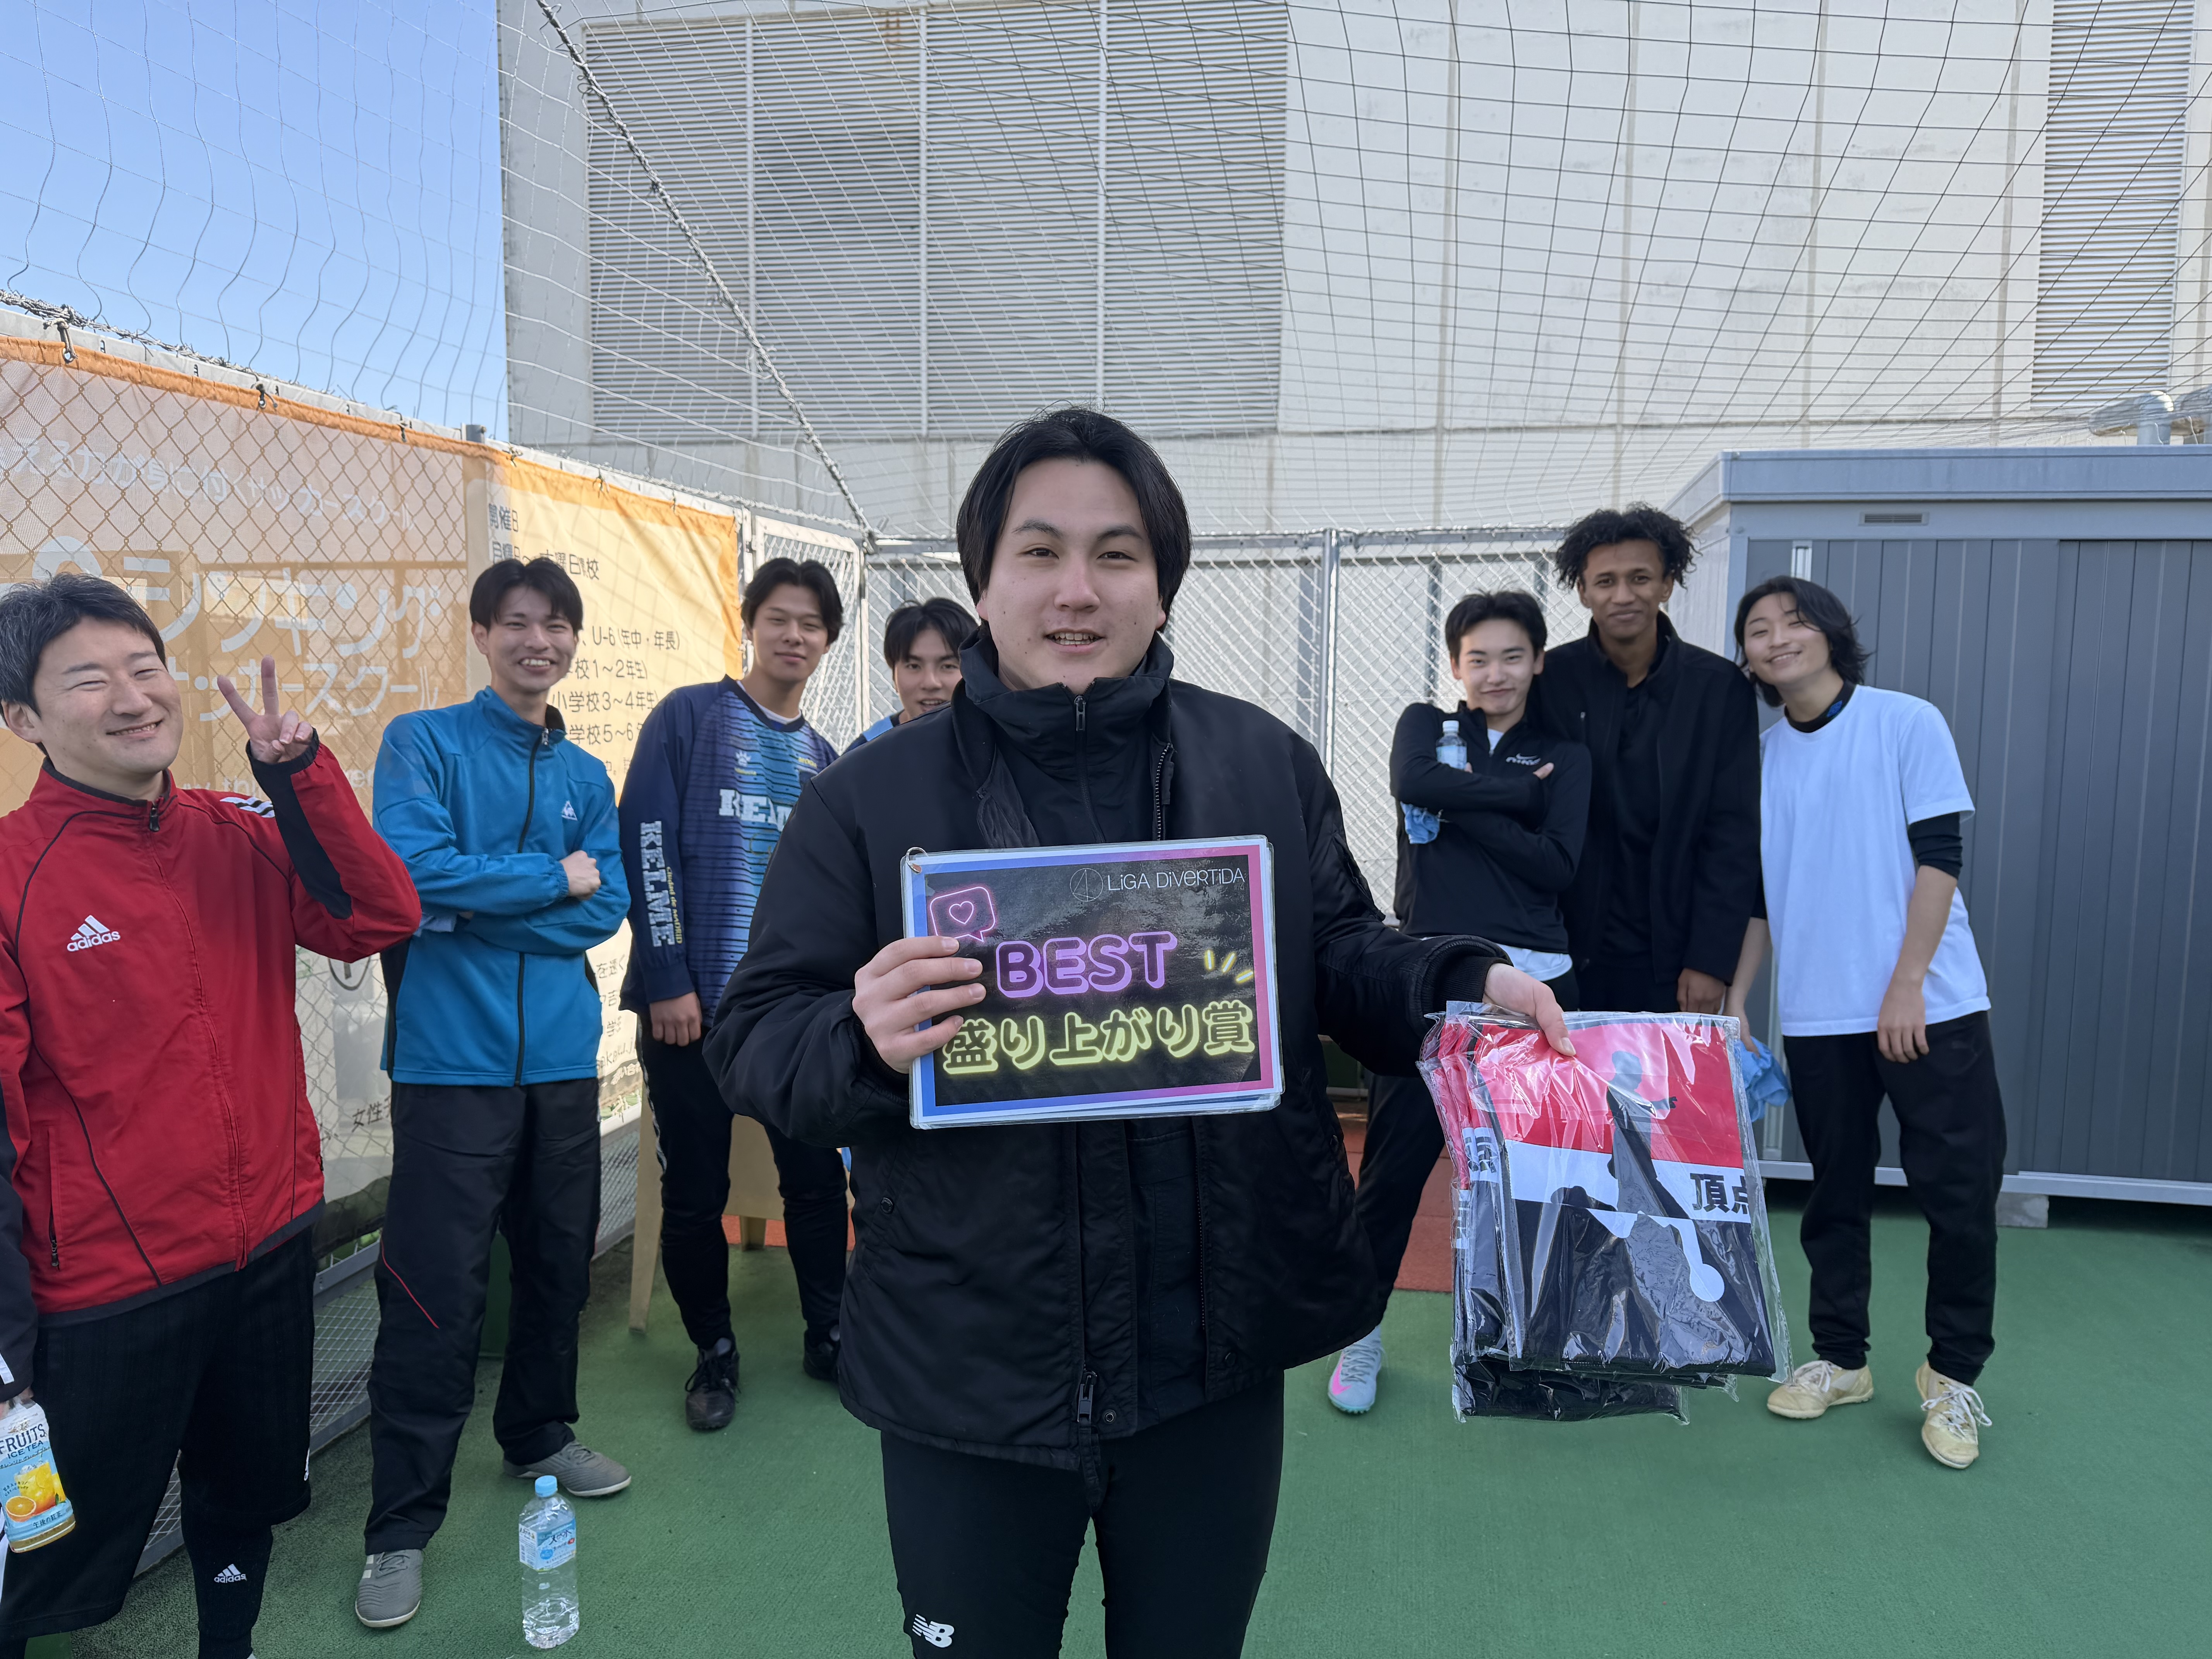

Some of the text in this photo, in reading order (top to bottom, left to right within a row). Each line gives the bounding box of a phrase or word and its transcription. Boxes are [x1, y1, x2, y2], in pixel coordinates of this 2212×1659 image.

[0, 438, 415, 531] える力が身に付くサッカースクール
[488, 503, 519, 532] 開催日
[568, 658, 648, 680] 校1～2年生)
[641, 821, 675, 947] KELME
[67, 931, 120, 951] adidas
[995, 930, 1178, 998] BEST
[943, 1000, 1255, 1075] 盛り上がり賞
[0, 1424, 45, 1455] FRUITS
[8, 1440, 43, 1459] ICE TEA
[214, 1574, 247, 1583] adidas
